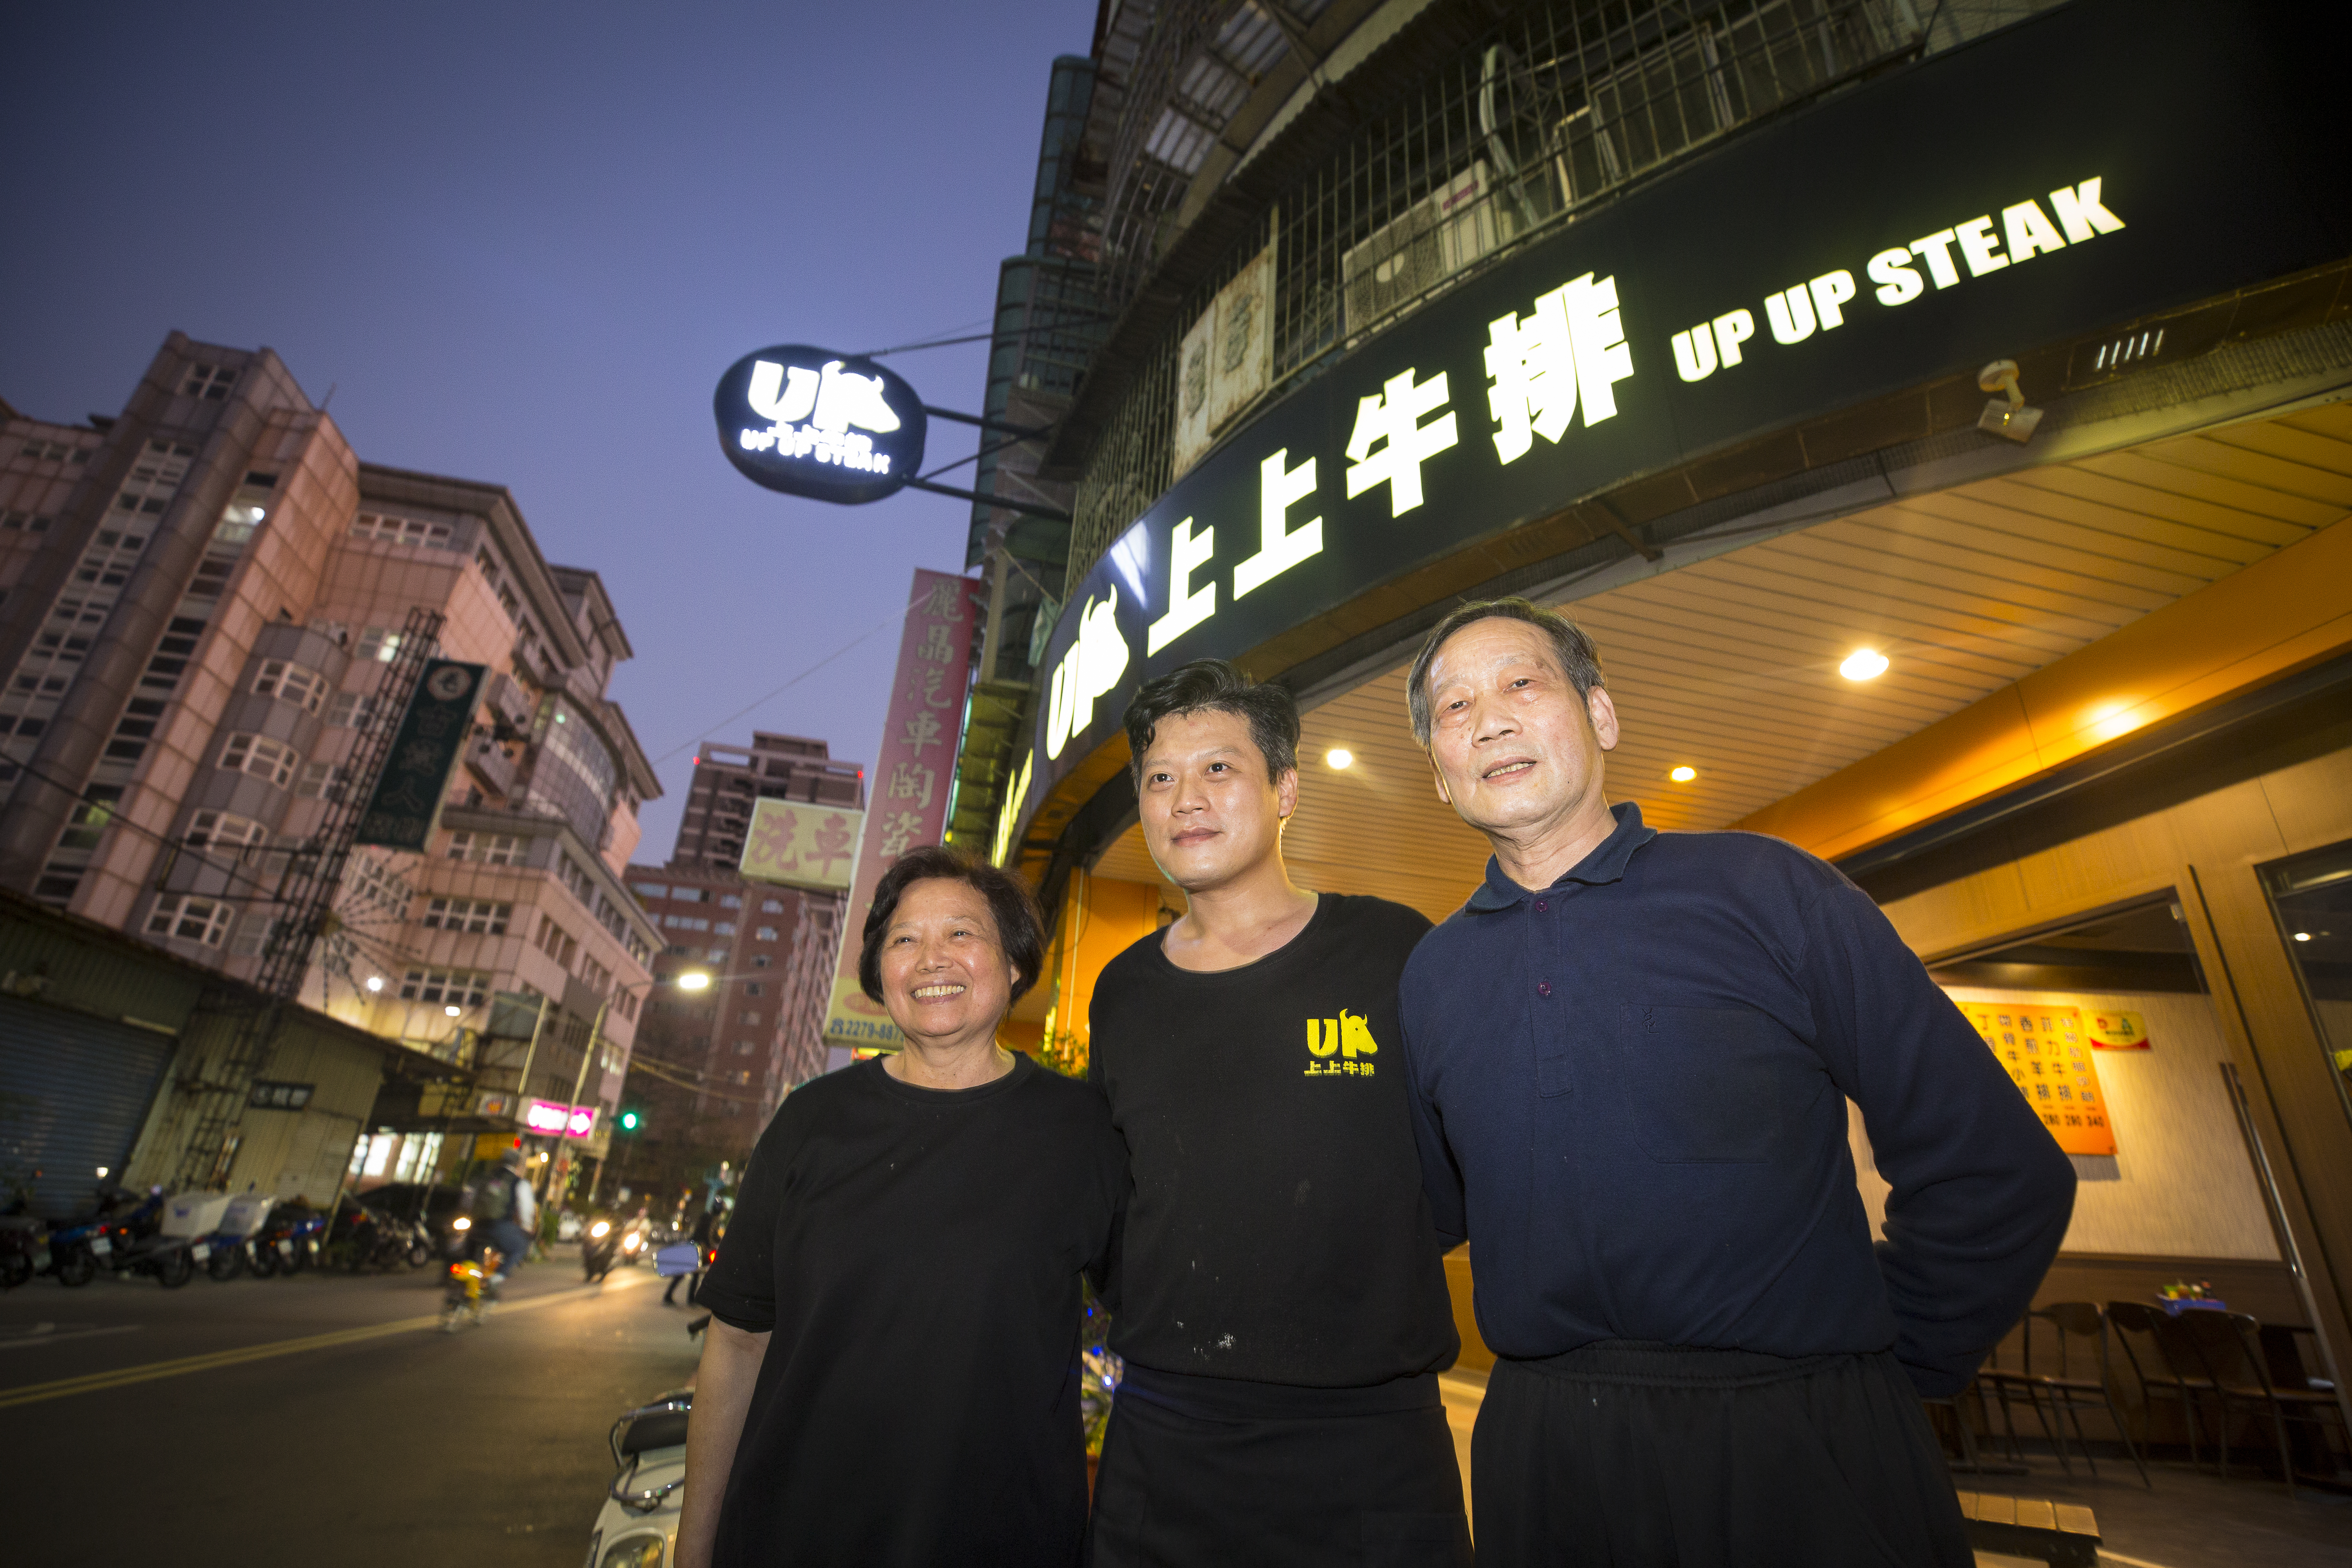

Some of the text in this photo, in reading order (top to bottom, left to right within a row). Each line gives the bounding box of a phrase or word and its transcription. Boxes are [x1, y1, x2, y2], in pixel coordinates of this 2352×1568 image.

[1671, 176, 2126, 382] UP UP STEAK
[1147, 271, 1635, 657] 上上牛排
[751, 809, 853, 879] 洗車
[1304, 1060, 1375, 1077] 上上牛排
